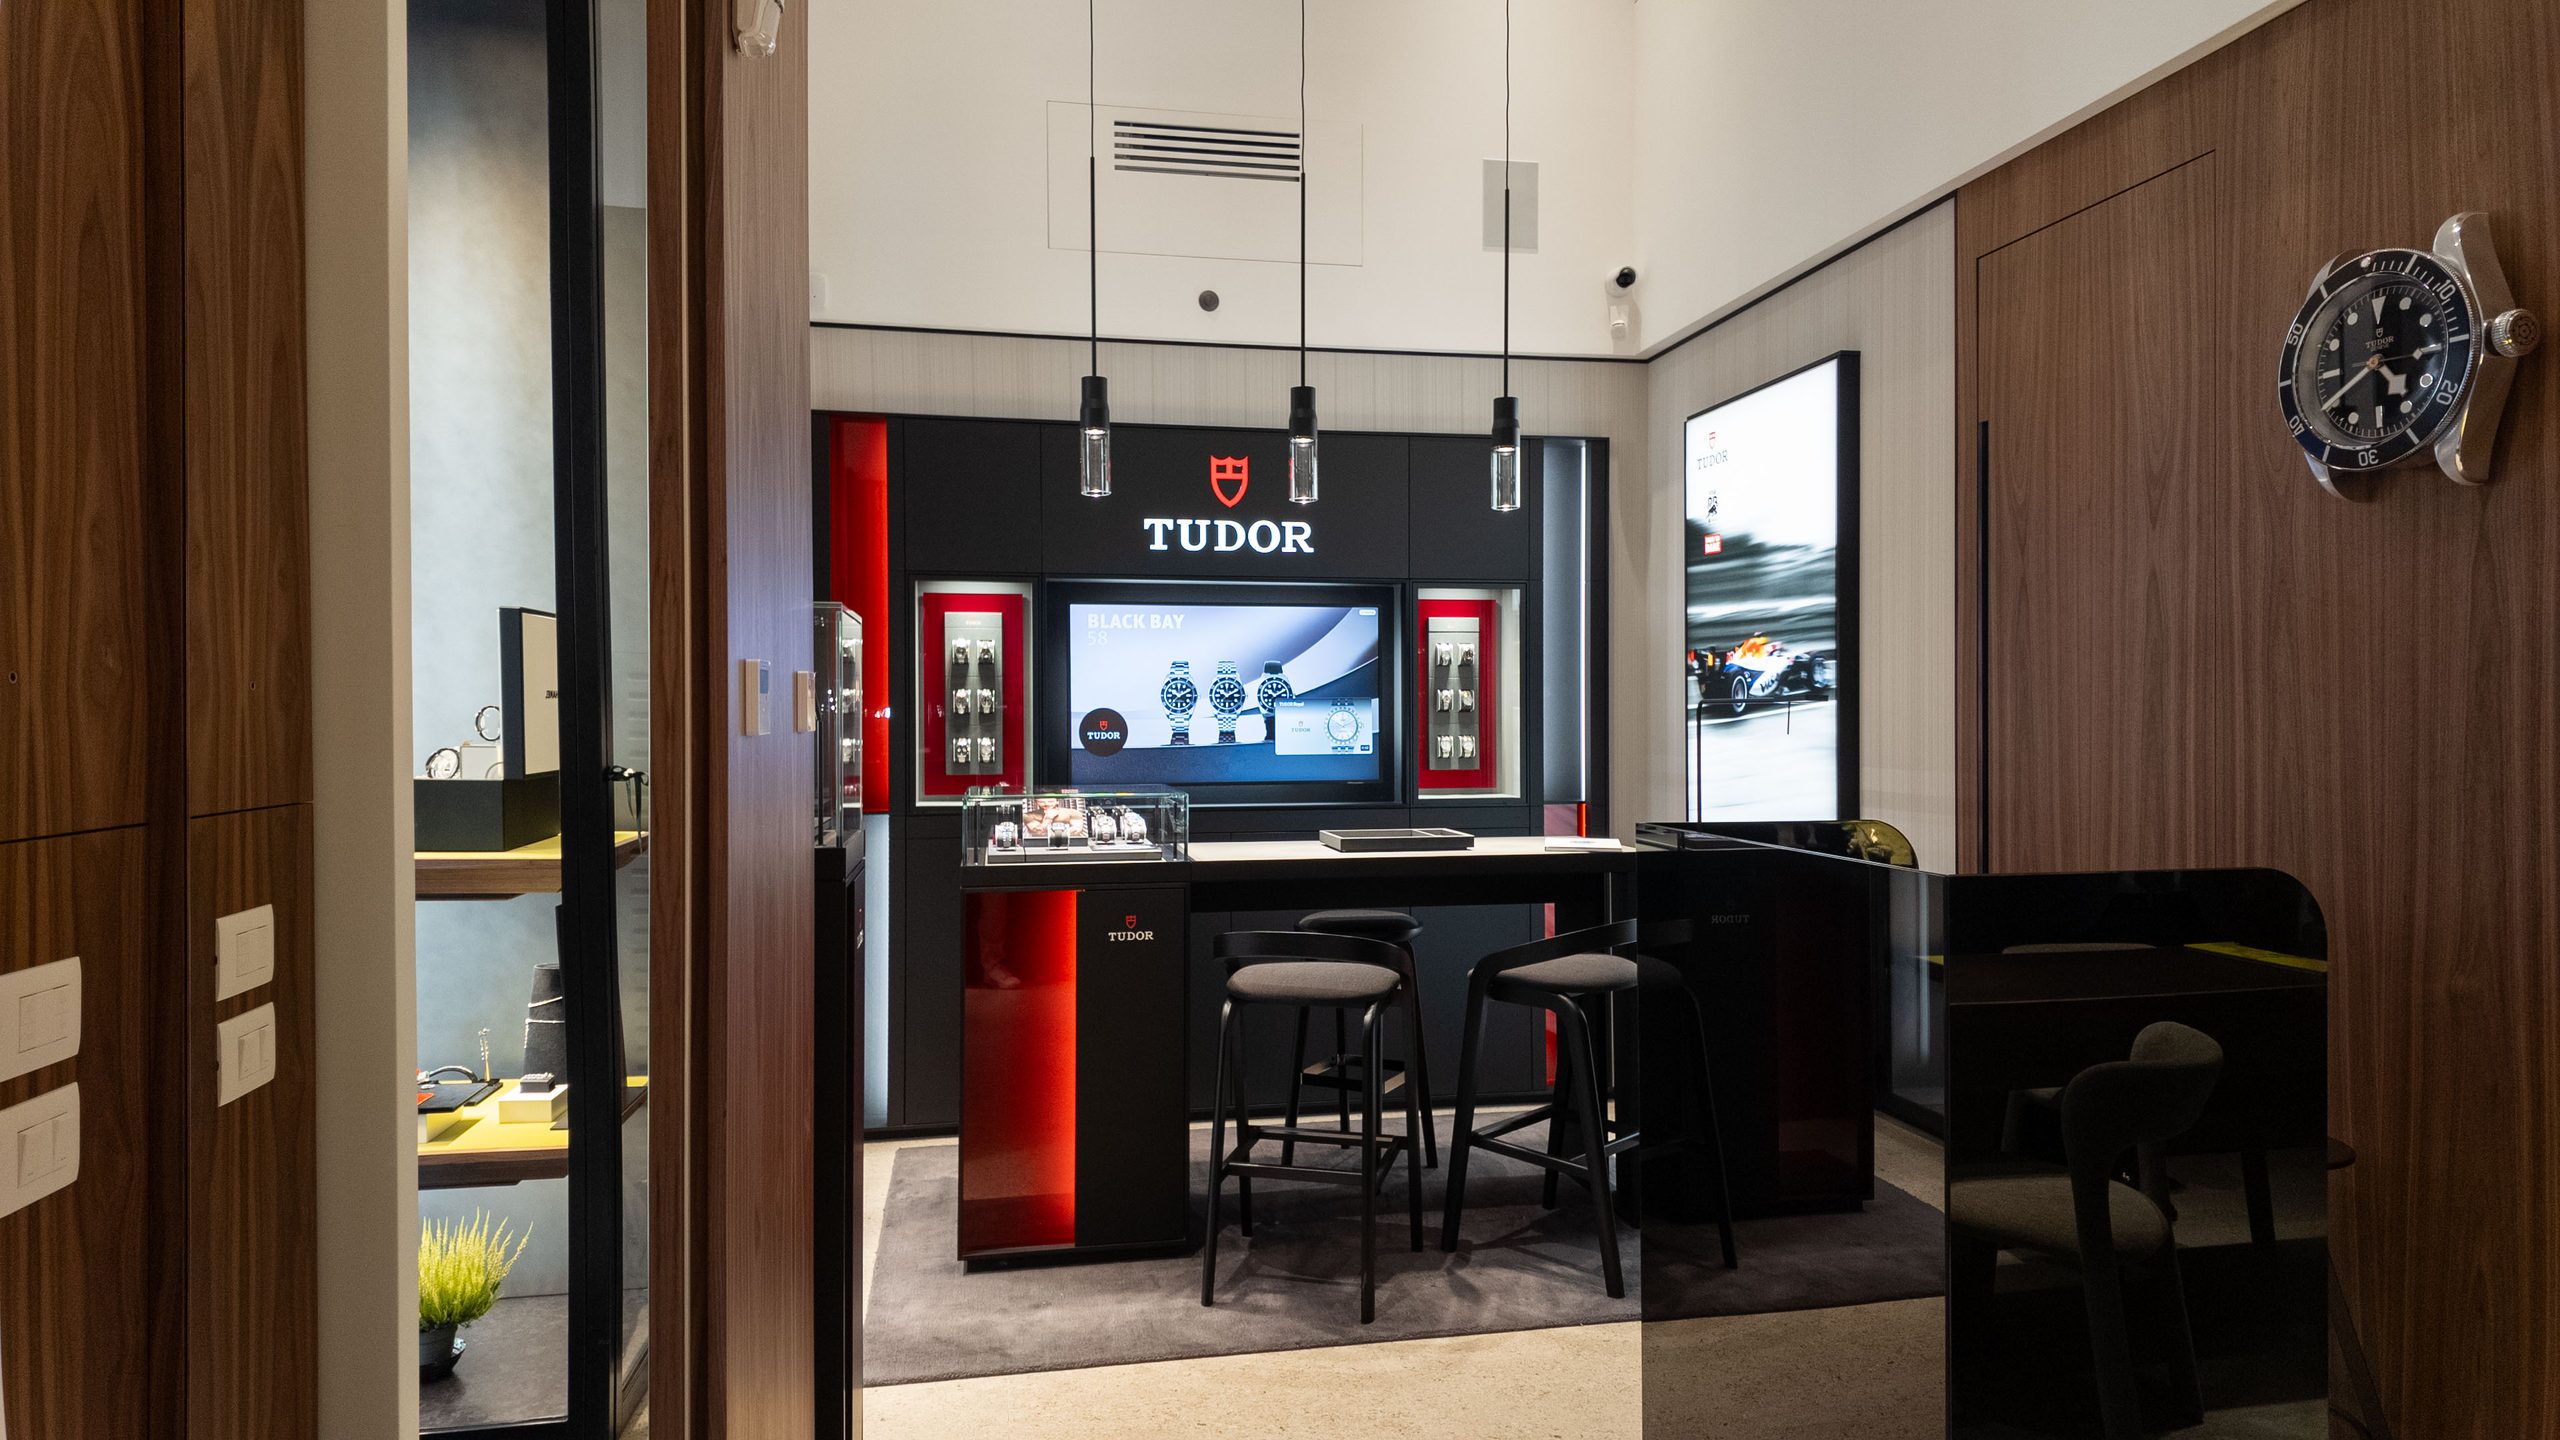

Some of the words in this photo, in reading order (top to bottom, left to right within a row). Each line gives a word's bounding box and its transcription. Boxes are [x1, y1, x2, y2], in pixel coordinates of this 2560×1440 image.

[2437, 280, 2456, 300] 10
[2287, 323, 2303, 346] 50
[2365, 336, 2395, 348] TUDOR
[2436, 380, 2458, 405] 20
[2289, 415, 2305, 435] 40
[1697, 450, 1728, 470] TUDOR
[2358, 449, 2379, 466] 30
[1144, 518, 1315, 554] TUDOR
[1088, 613, 1146, 629] BLACK
[1150, 614, 1185, 629] BAY
[1088, 630, 1109, 646] 58
[1087, 731, 1121, 740] TUDOR
[1108, 931, 1154, 942] TUDOR
